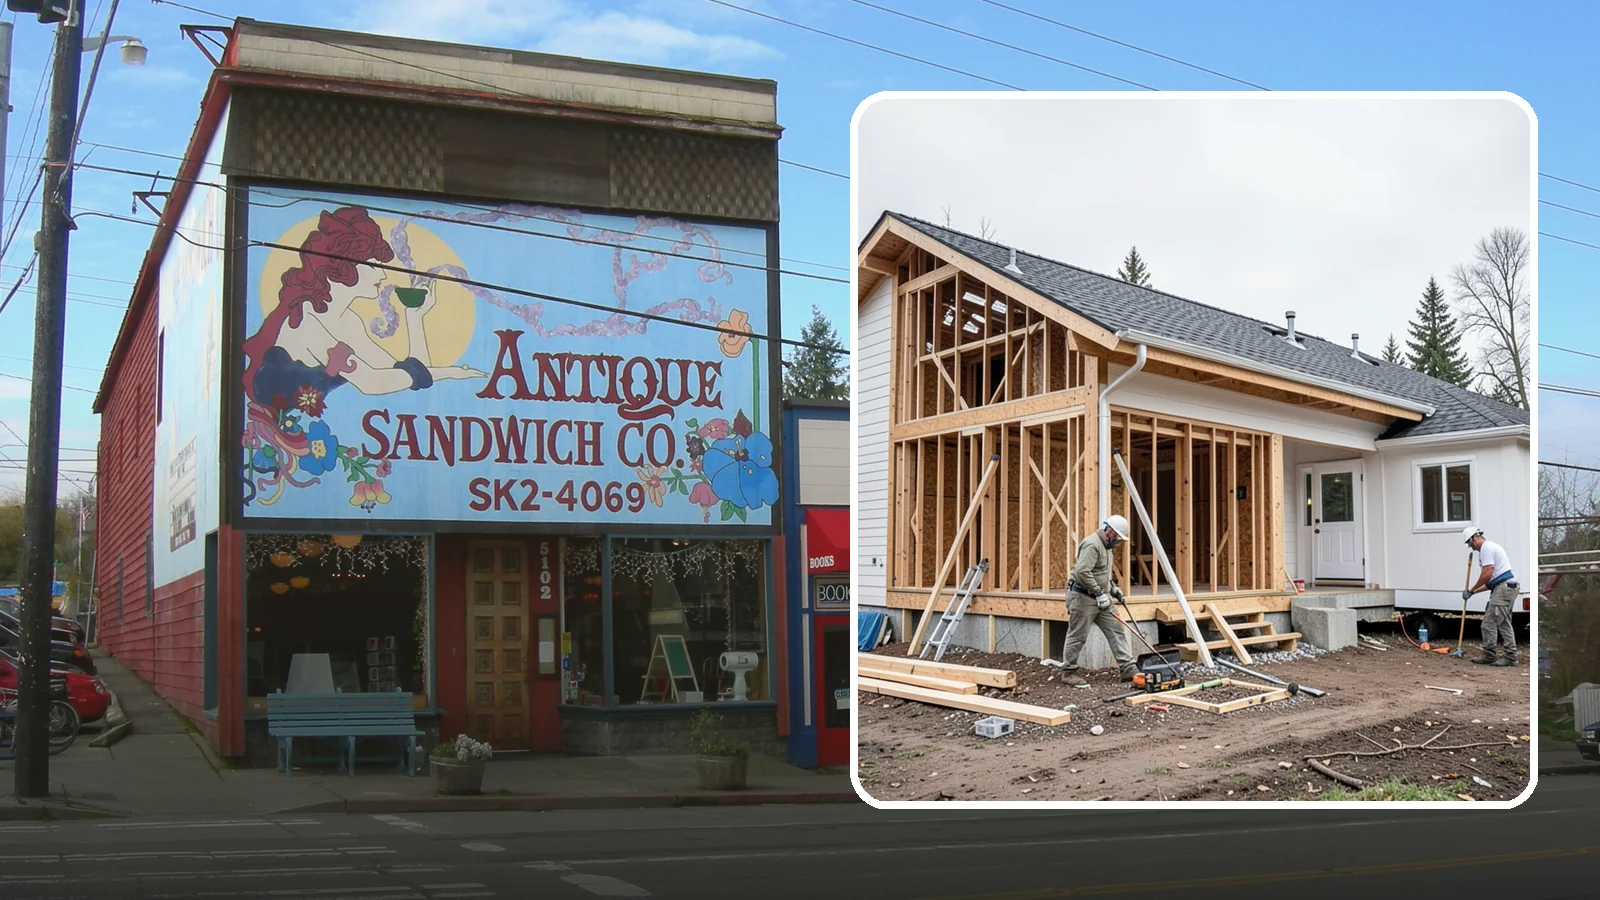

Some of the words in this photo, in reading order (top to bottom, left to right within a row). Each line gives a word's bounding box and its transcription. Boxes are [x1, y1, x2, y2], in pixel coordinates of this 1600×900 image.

[475, 329, 723, 421] ANTIQUE
[361, 408, 604, 467] SANDWICH
[617, 422, 685, 469] CO.
[468, 477, 646, 513] SK2-4069
[540, 541, 551, 600] 5102
[809, 555, 835, 569] BOOKS
